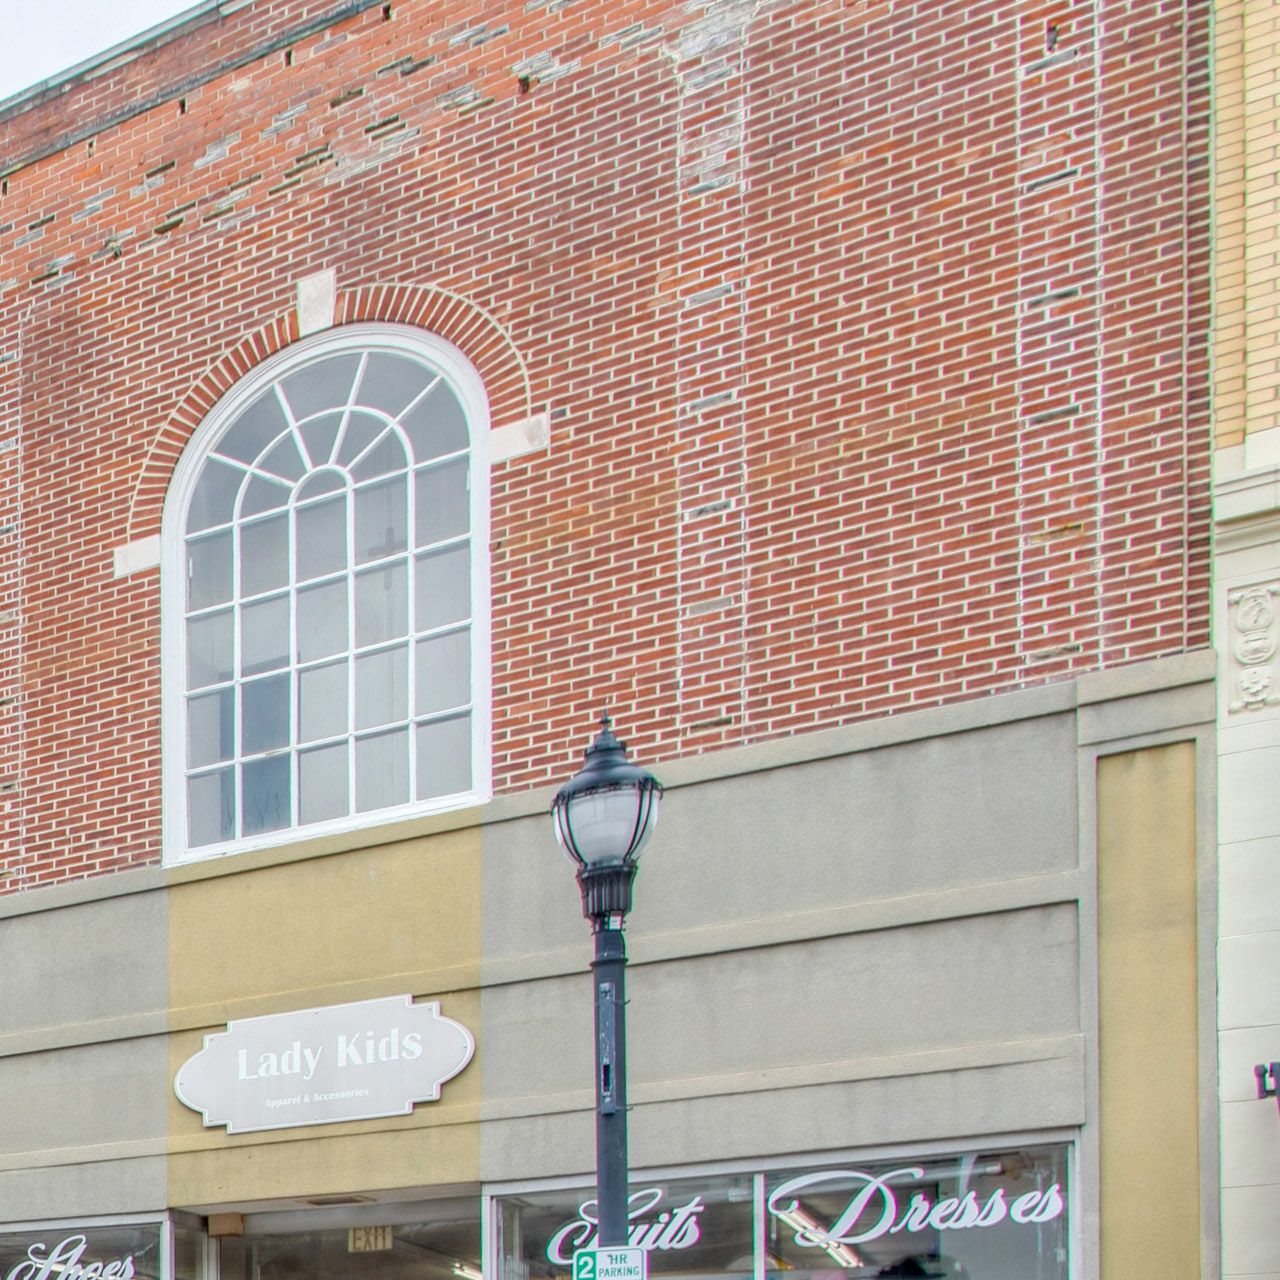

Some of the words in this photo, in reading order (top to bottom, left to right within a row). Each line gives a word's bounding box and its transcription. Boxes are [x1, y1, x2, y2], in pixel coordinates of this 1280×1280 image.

[237, 1041, 323, 1080] Lady
[337, 1027, 423, 1068] Kids
[265, 1094, 301, 1110] Apparel
[302, 1093, 310, 1103] &
[312, 1087, 370, 1102] Accessories
[768, 1167, 1064, 1248] Dresses
[352, 1226, 389, 1251] EXIT
[546, 1188, 705, 1266] Suits
[578, 1256, 594, 1279] 2
[609, 1254, 628, 1265] HR
[598, 1266, 640, 1277] PARKING
